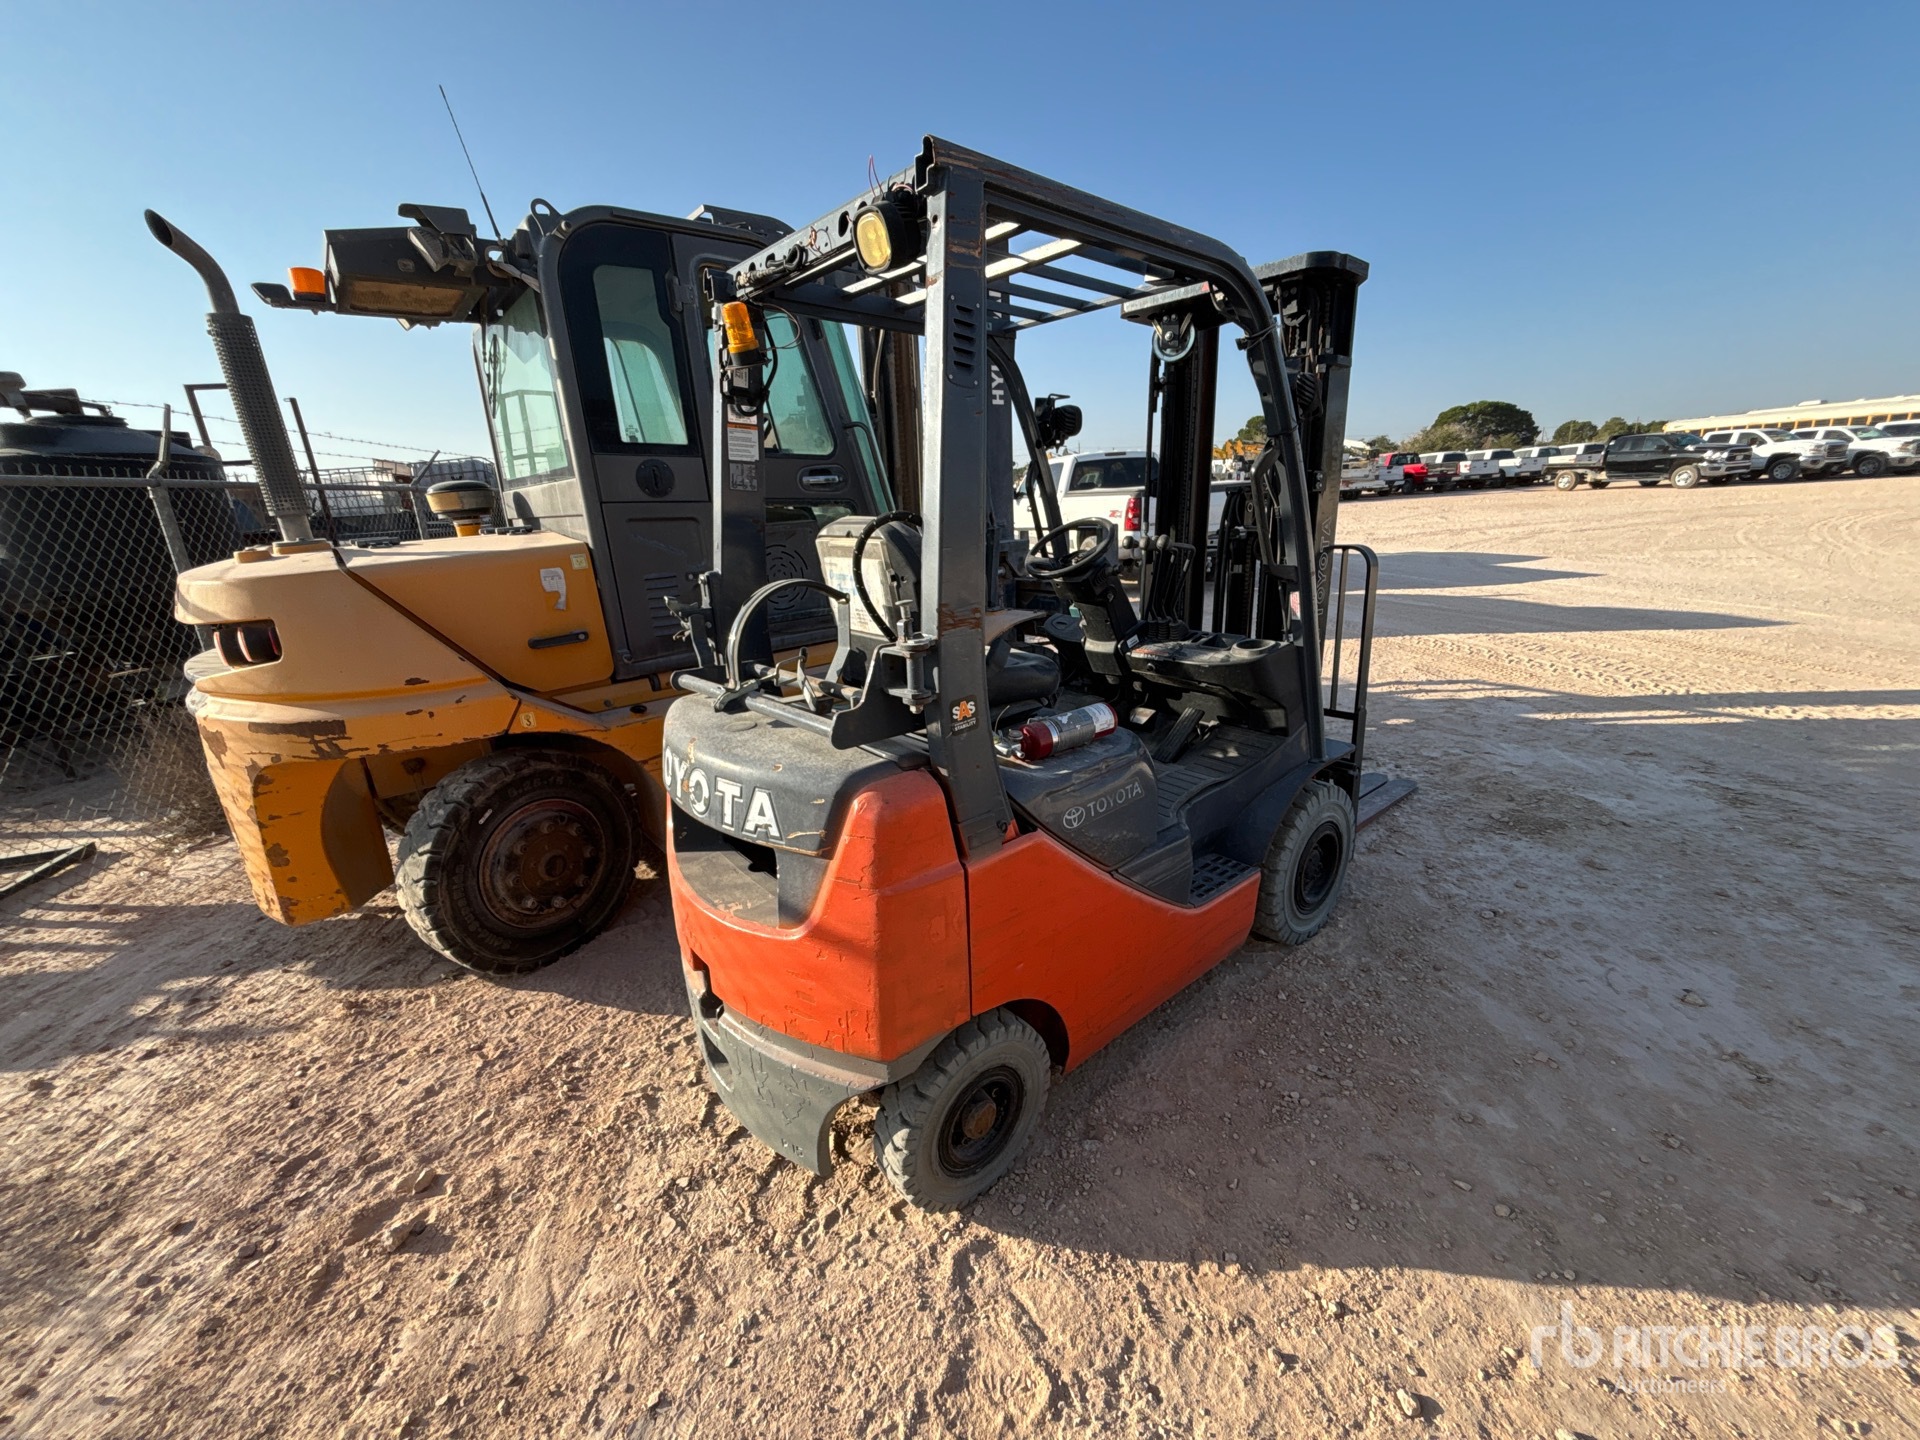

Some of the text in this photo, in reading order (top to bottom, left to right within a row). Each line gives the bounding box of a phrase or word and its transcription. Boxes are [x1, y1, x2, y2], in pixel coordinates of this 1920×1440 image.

[952, 701, 976, 721] SAS
[664, 746, 785, 844] OYOTA
[1087, 781, 1142, 817] TOYOTA
